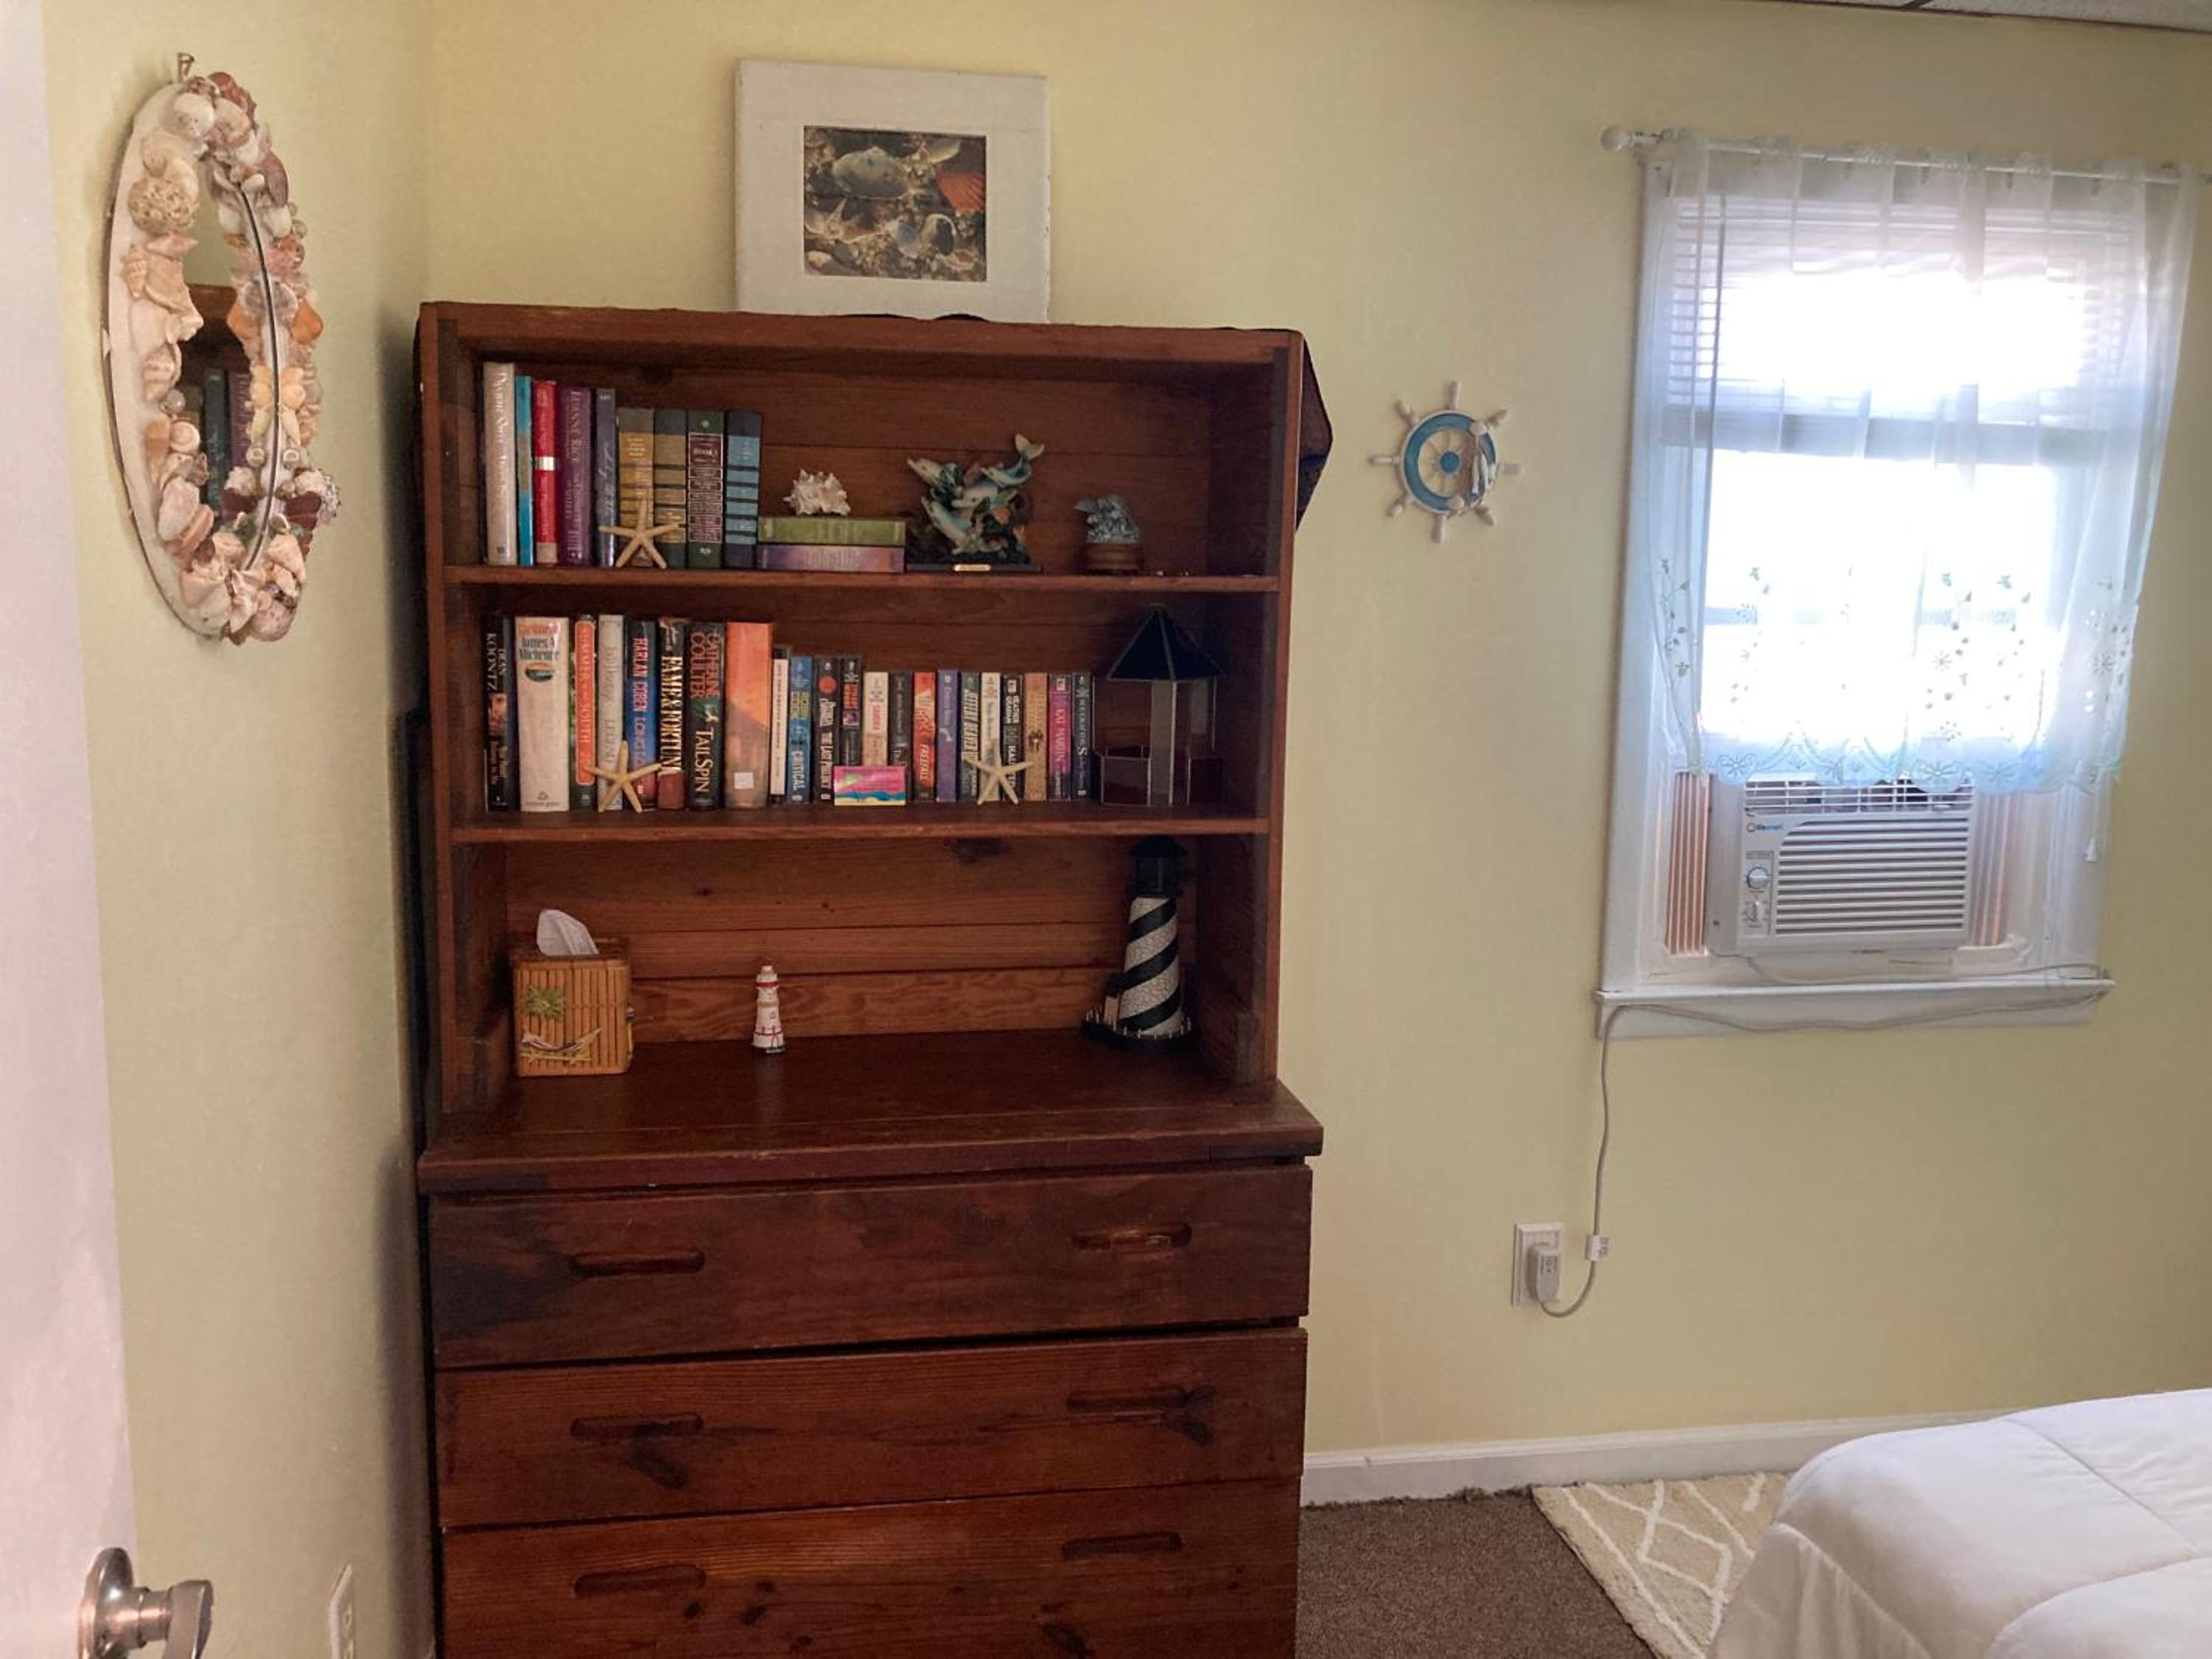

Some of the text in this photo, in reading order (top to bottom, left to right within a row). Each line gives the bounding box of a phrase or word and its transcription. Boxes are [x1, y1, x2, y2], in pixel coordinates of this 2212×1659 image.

[485, 633, 498, 690] KOONTZ
[633, 638, 649, 677] HARLAN
[661, 656, 684, 697] FAME
[690, 632, 706, 699] COULTER
[706, 632, 721, 698] CATHERINE
[633, 681, 649, 712] COBEN
[791, 751, 805, 791] CRITICAL
